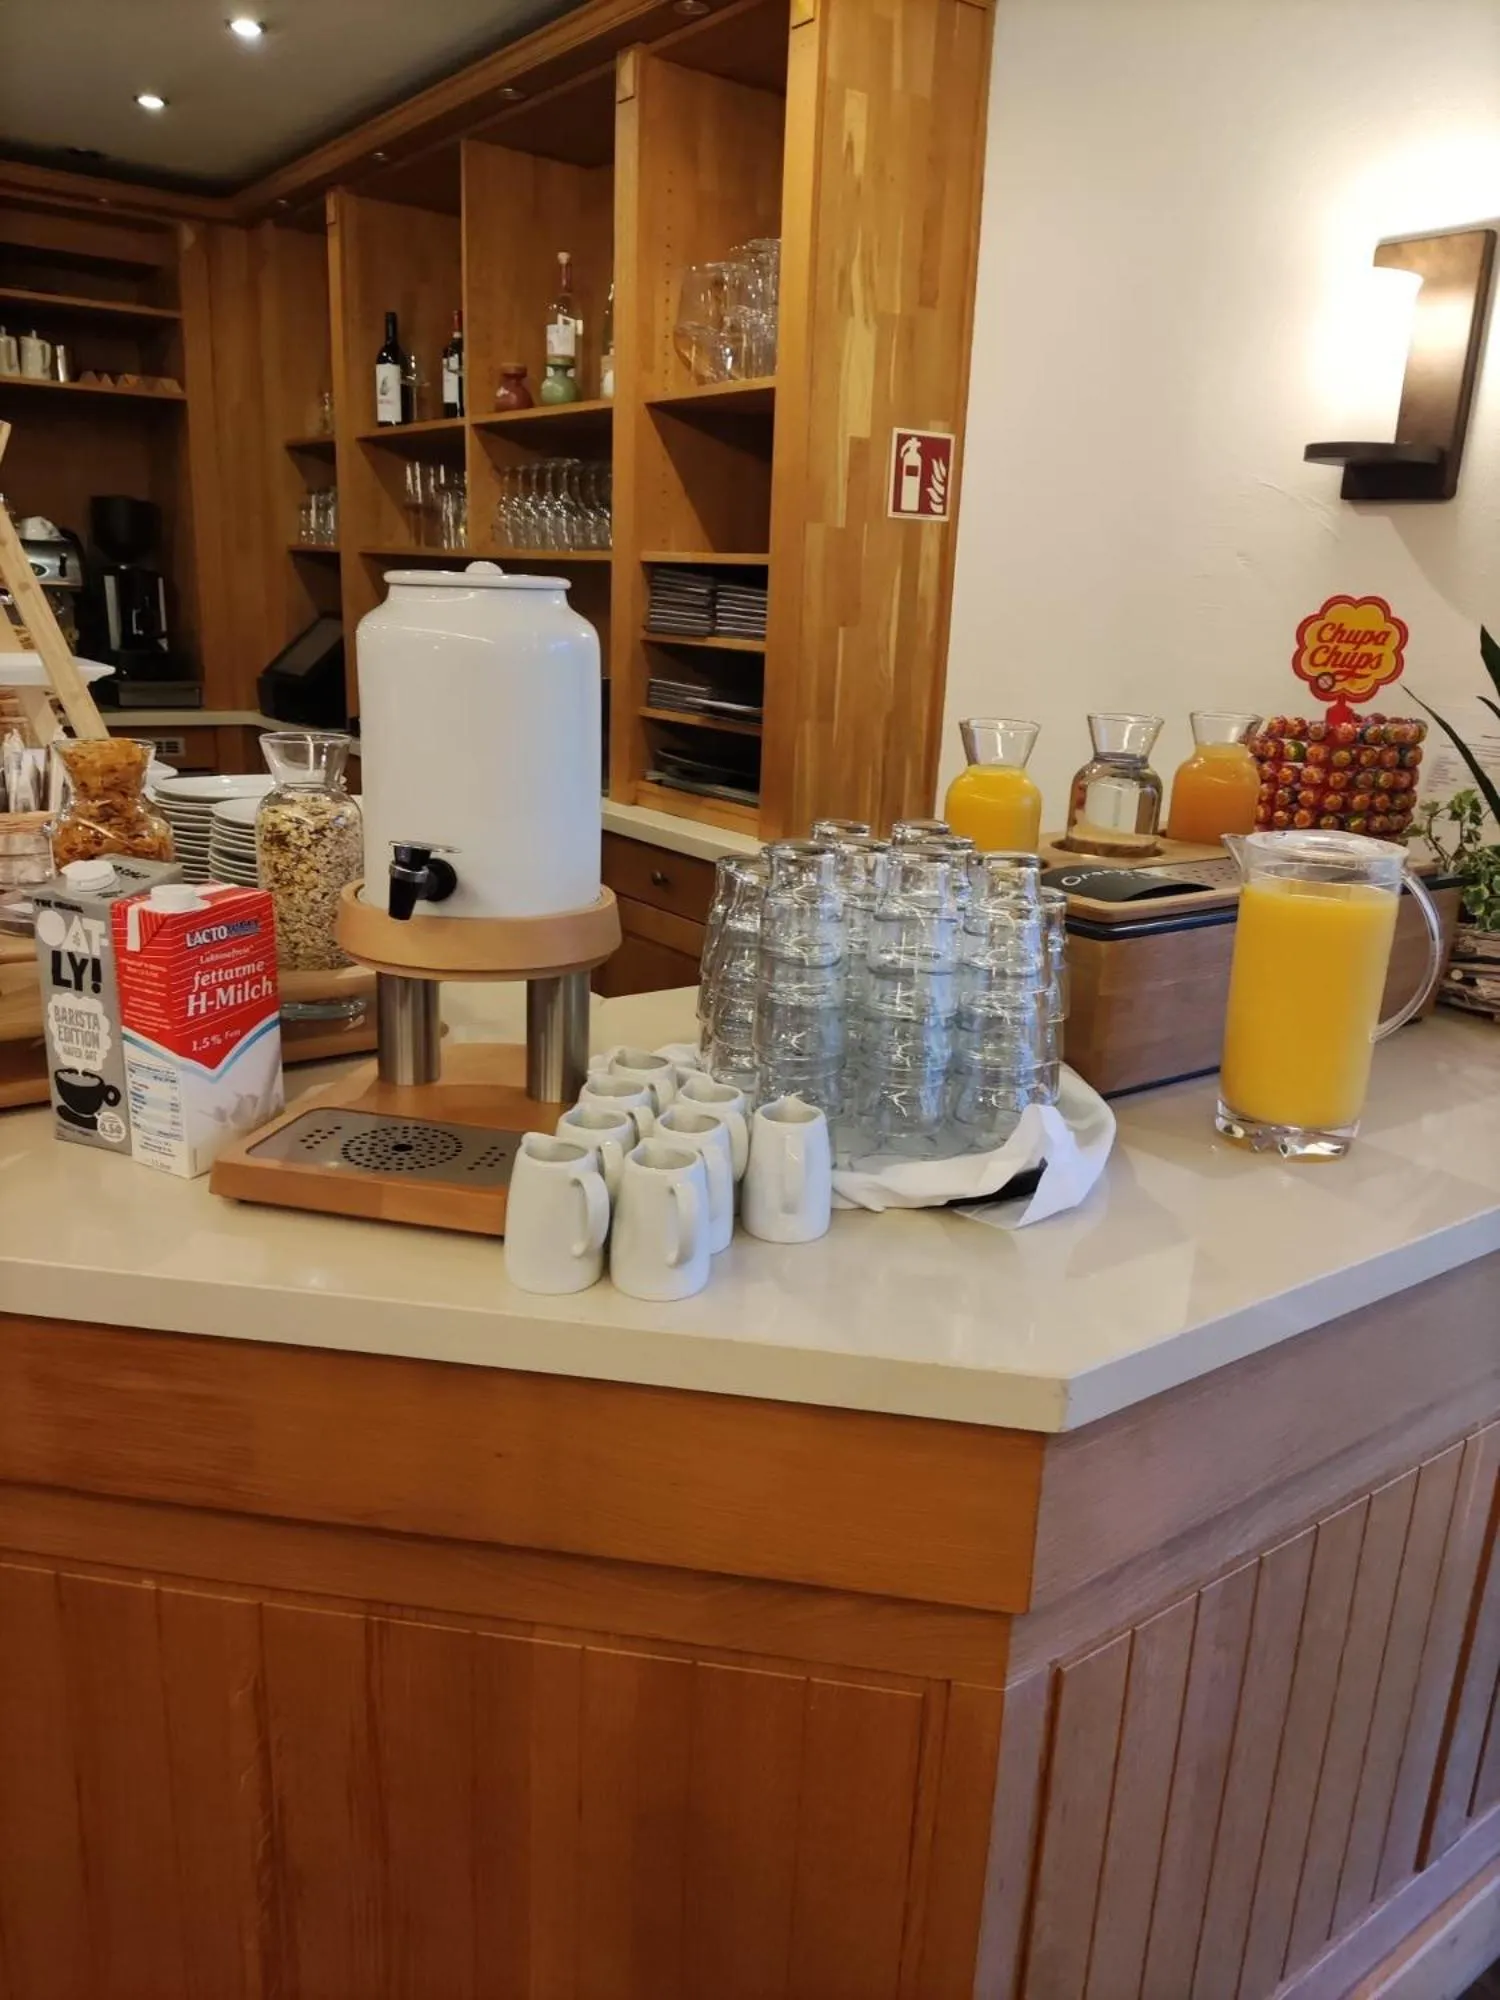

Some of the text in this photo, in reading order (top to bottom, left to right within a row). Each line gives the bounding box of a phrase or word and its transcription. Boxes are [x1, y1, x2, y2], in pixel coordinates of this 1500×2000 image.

[1316, 622, 1392, 650] Chupa
[1308, 645, 1385, 675] Chups
[186, 924, 229, 948] LACTO
[51, 950, 102, 994] LY!
[191, 960, 265, 993] fettarme
[187, 975, 273, 1017] H-Milch
[53, 1004, 101, 1031] BARISTA
[57, 1024, 100, 1049] EDITION
